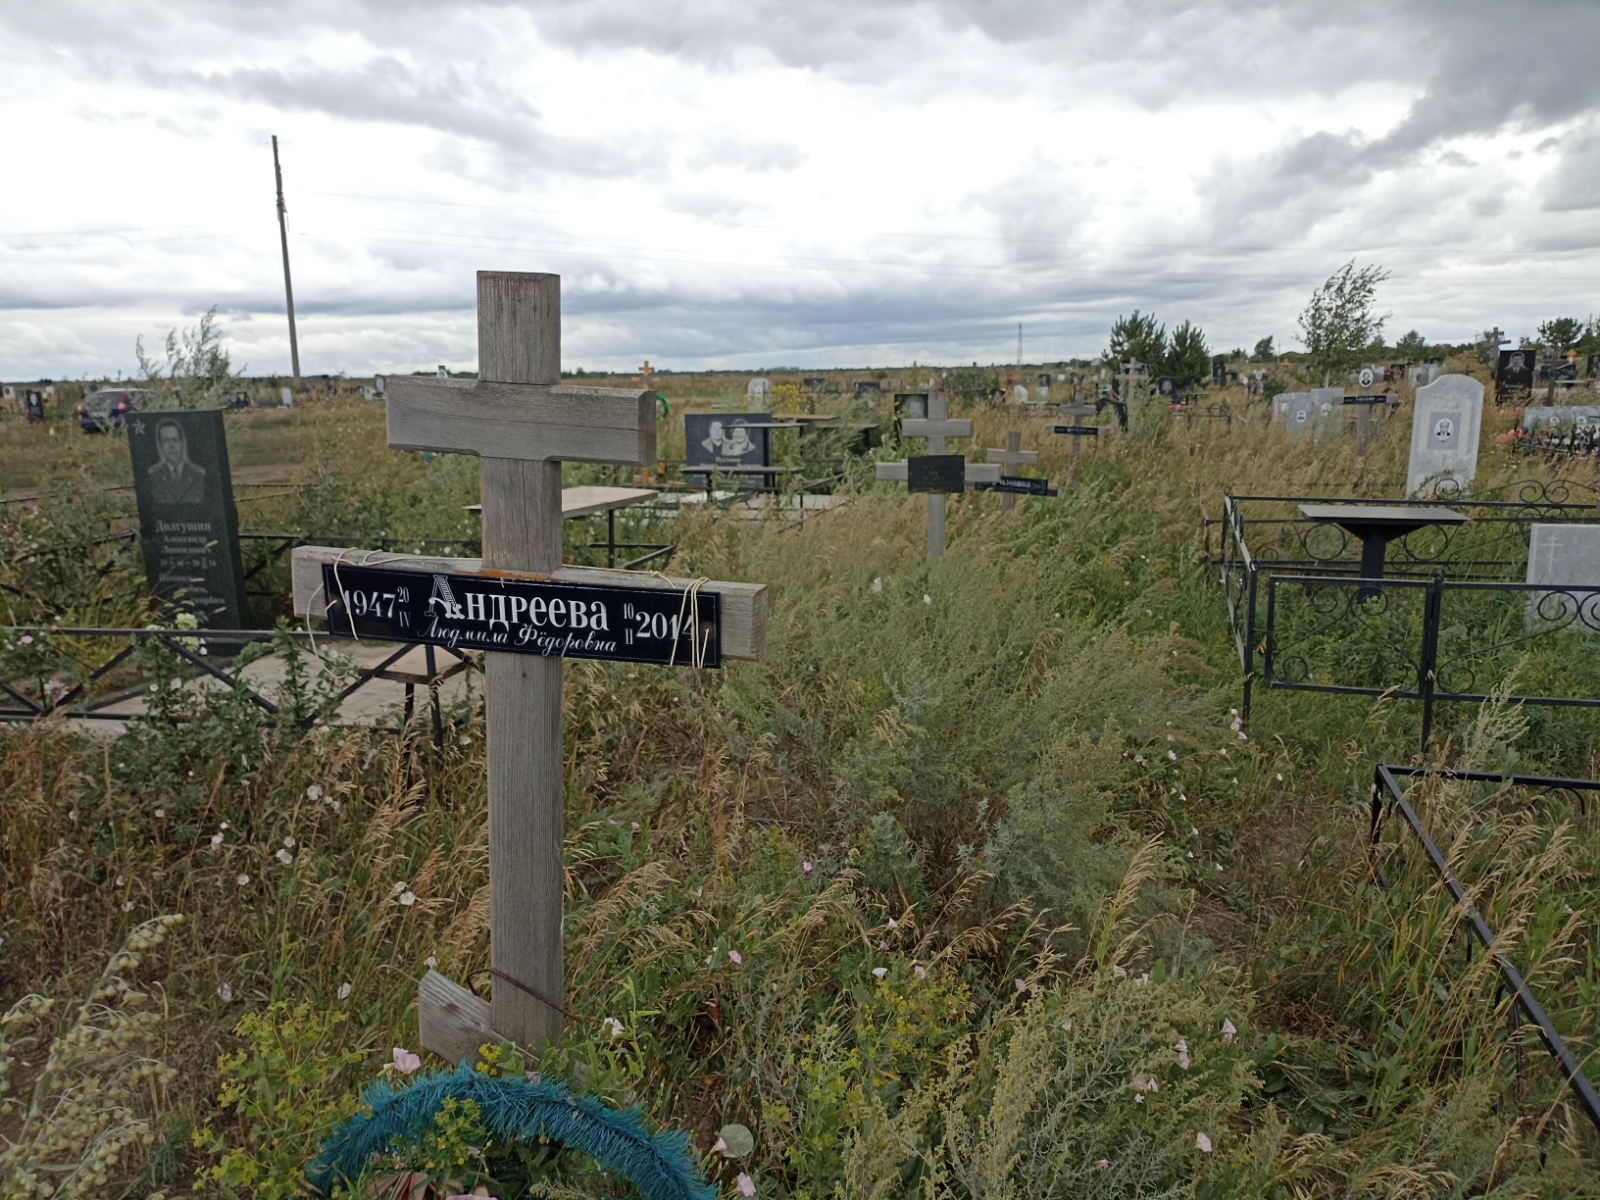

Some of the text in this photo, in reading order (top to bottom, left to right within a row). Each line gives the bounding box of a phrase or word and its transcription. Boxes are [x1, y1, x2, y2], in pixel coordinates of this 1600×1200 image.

[156, 520, 212, 534] Долгушин
[343, 589, 397, 618] 1947
[397, 586, 410, 603] 20
[424, 574, 611, 632] Андреева
[623, 603, 634, 620] 10
[417, 616, 618, 657] Людмила Фёдоровна
